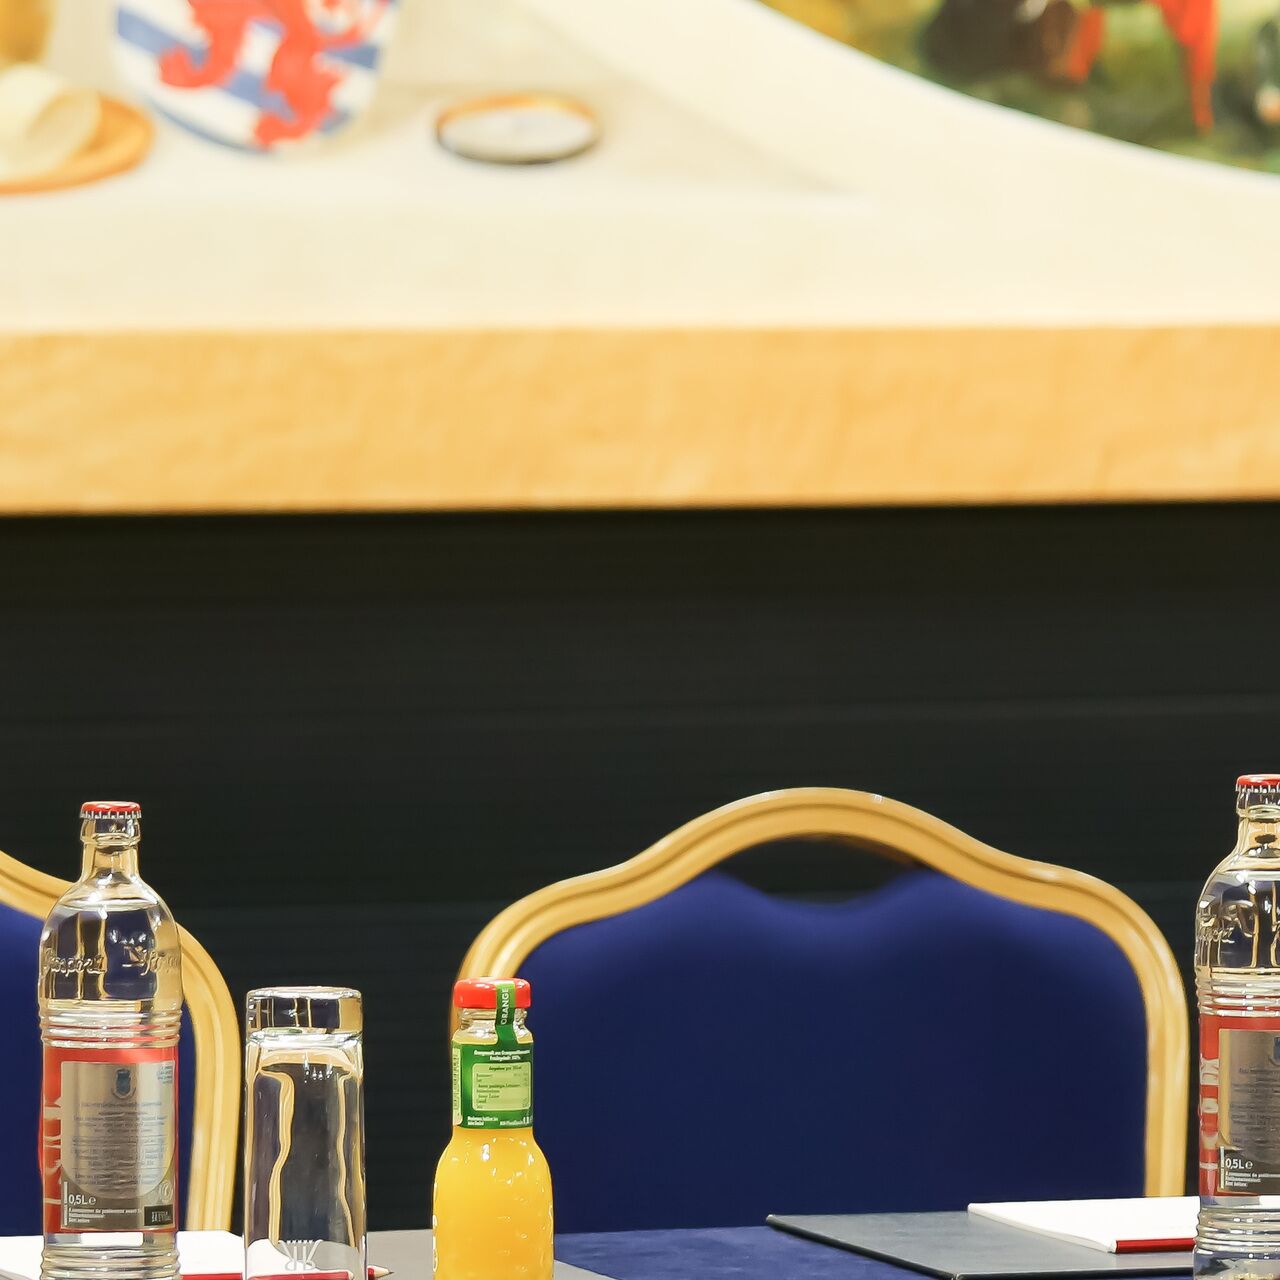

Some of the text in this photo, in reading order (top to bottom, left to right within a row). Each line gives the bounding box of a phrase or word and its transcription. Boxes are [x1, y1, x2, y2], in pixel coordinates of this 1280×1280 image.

[500, 987, 510, 1025] ORANGE
[1225, 1158, 1244, 1169] 0,5L
[69, 1194, 87, 1205] 0,5L
